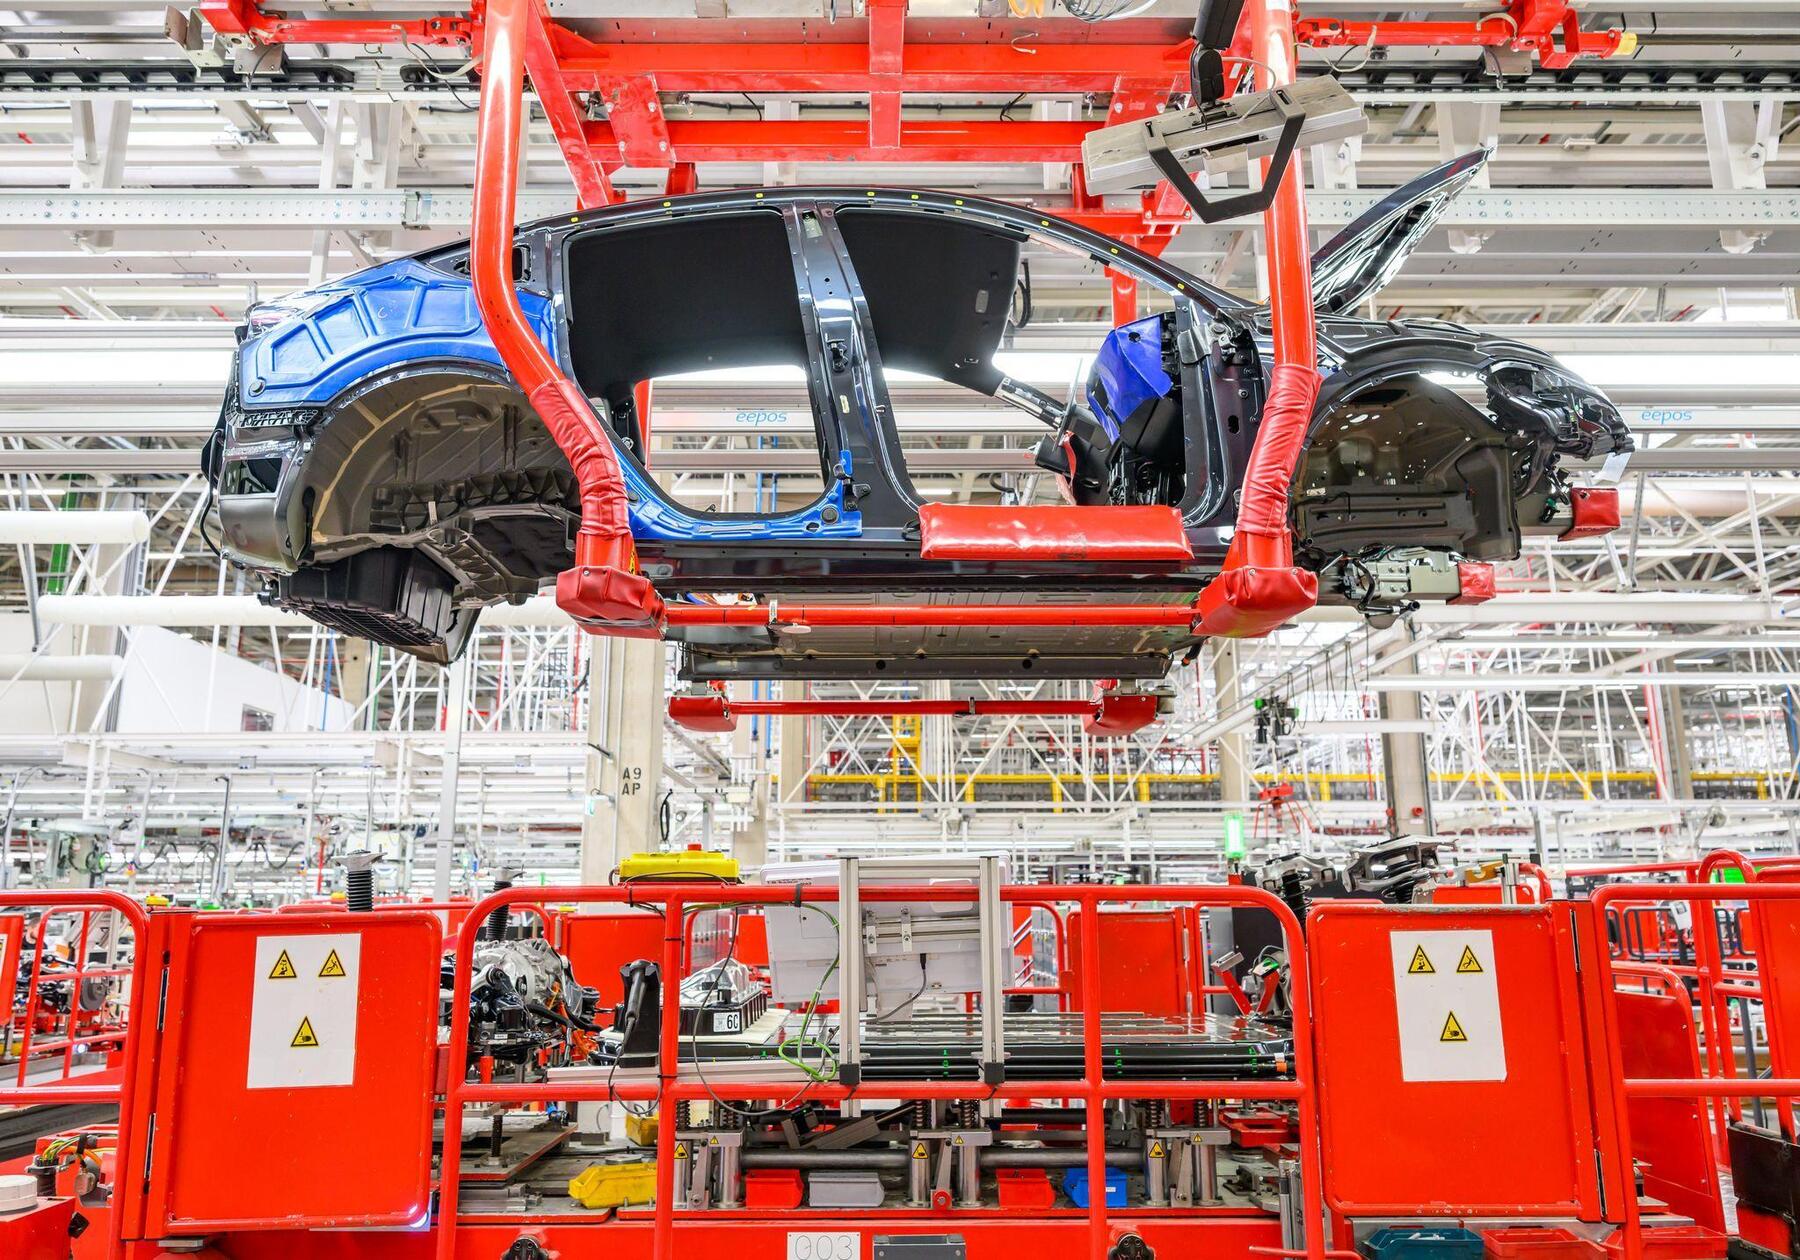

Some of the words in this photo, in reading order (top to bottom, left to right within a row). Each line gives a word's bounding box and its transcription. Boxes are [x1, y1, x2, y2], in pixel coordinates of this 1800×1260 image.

[735, 411, 787, 426] eepos
[1641, 409, 1692, 425] eepos
[621, 782, 641, 796] AP
[726, 1014, 738, 1029] 6C
[795, 1235, 852, 1260] 003
